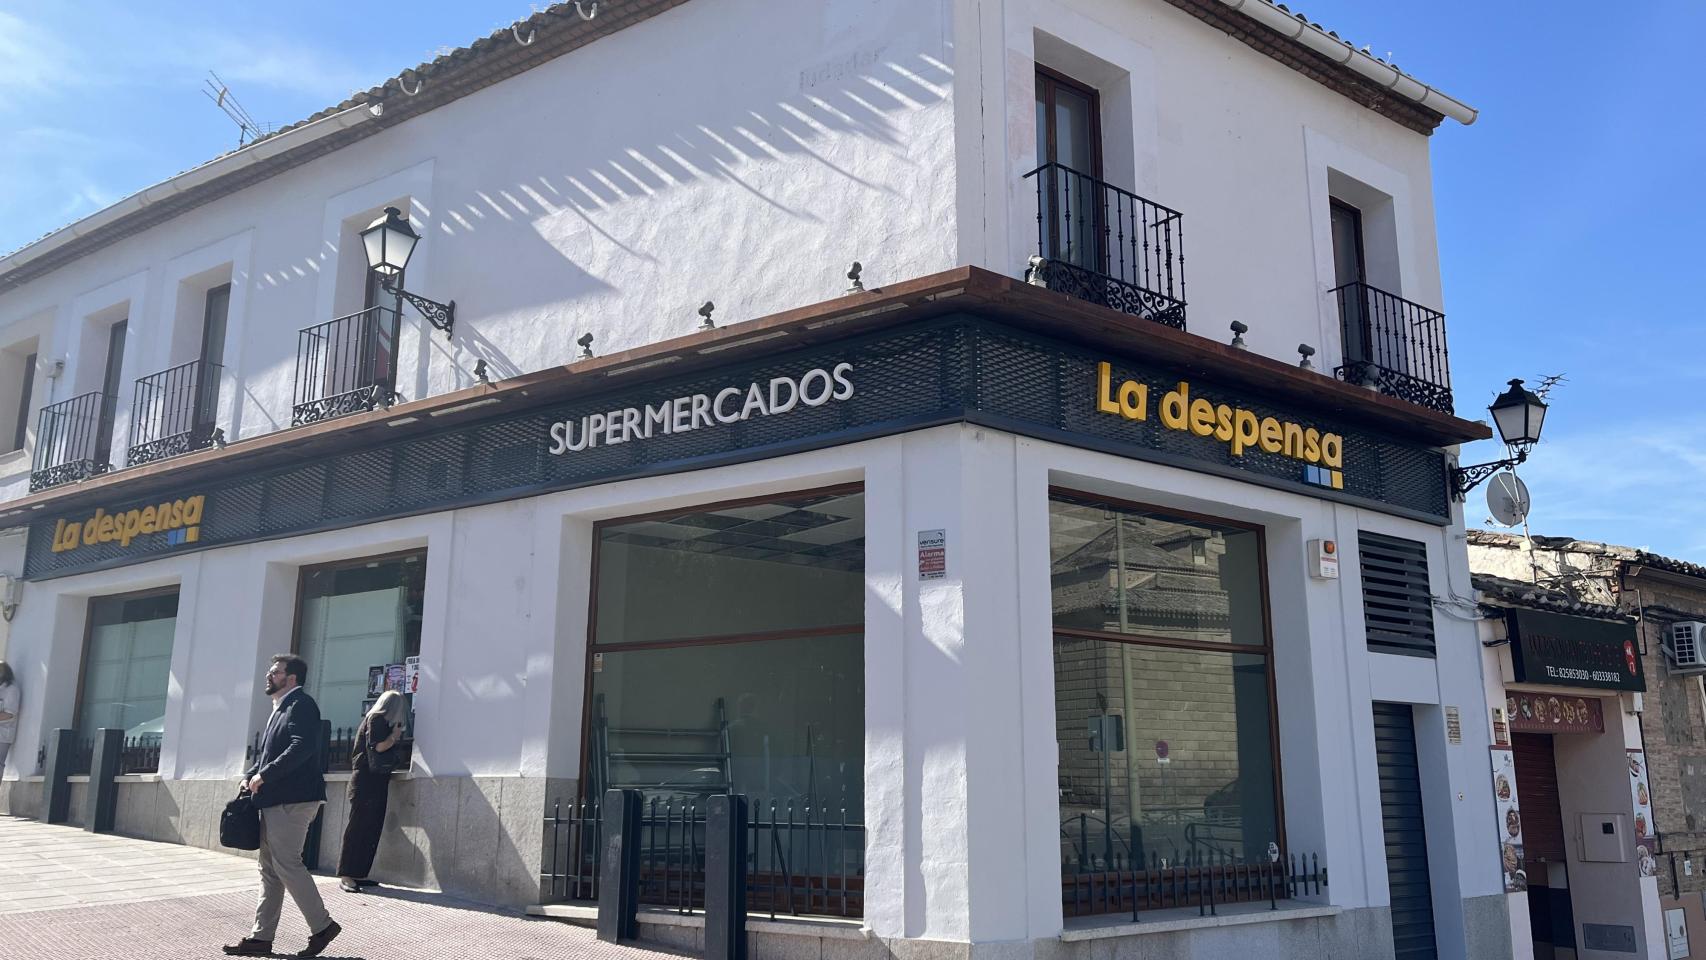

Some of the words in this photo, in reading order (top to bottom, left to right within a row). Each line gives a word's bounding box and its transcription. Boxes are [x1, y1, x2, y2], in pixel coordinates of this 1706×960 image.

[549, 362, 855, 456] SUPERMERCADOS
[1097, 361, 1148, 421] La
[1159, 381, 1342, 468] despensa
[52, 518, 82, 553] La
[83, 495, 205, 547] despensa
